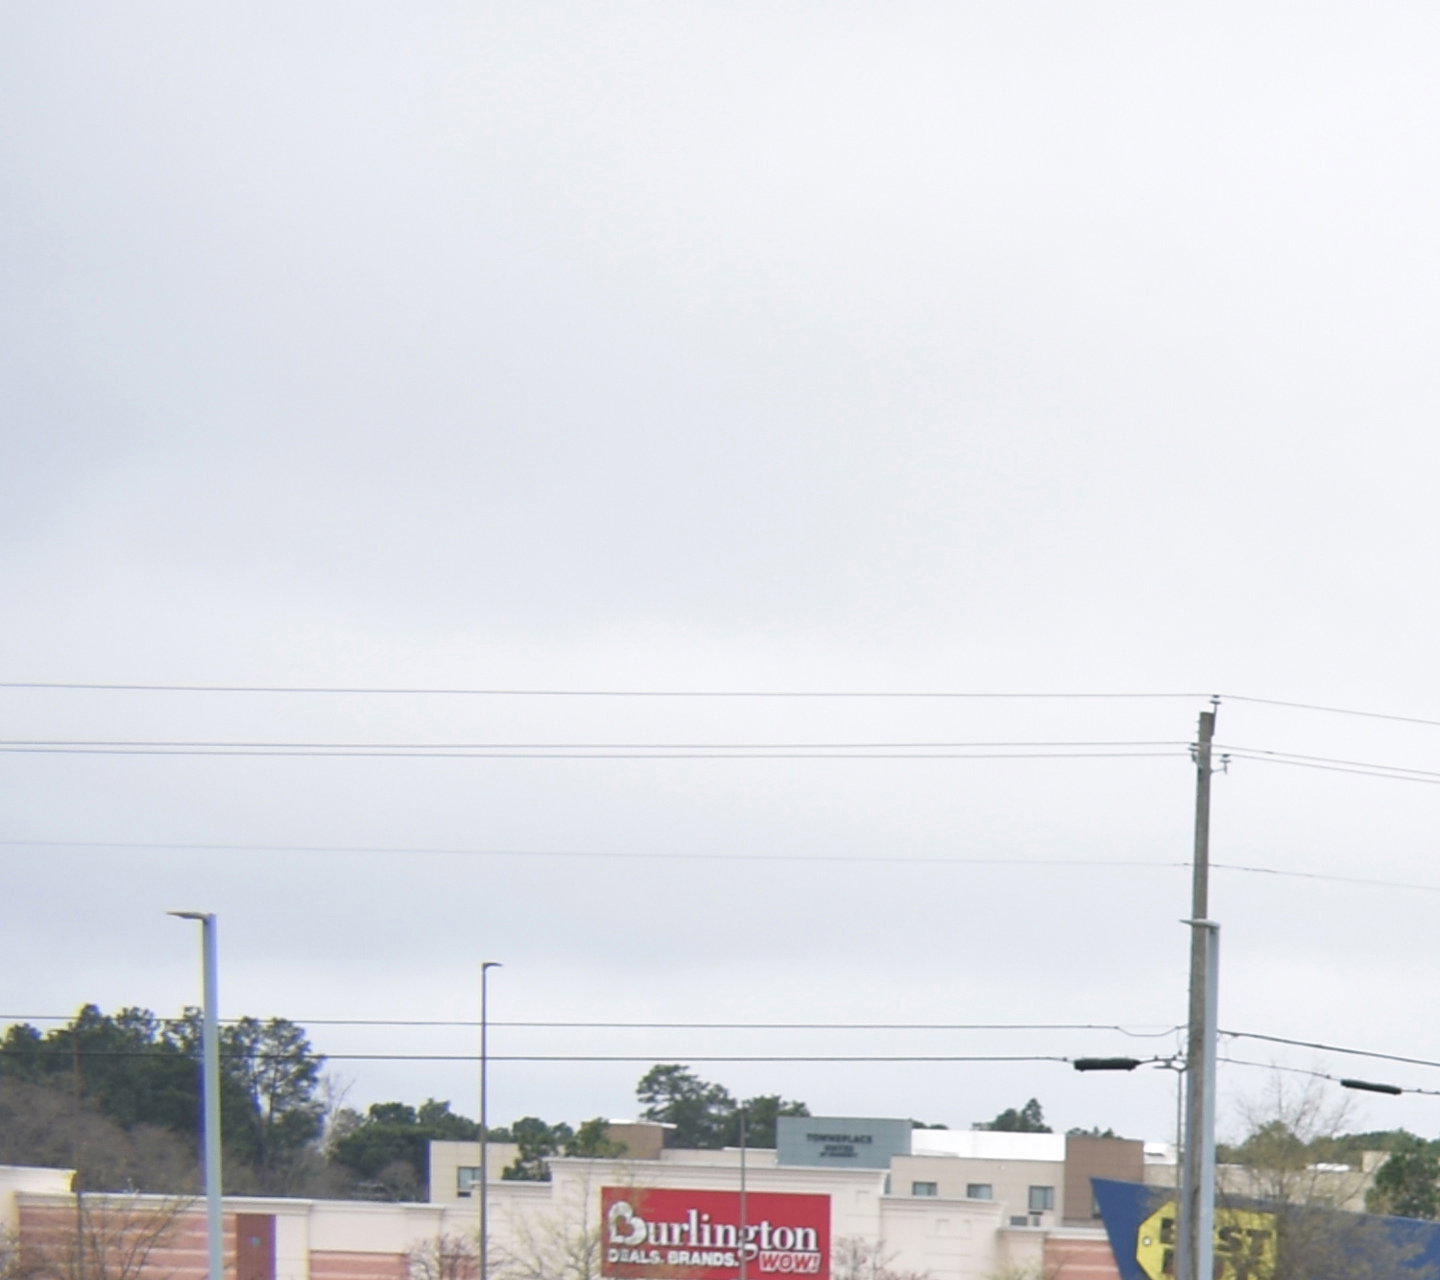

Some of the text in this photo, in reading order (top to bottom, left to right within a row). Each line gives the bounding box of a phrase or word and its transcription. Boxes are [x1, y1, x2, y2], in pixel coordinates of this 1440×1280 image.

[607, 1200, 818, 1261] Burlington
[1160, 1218, 1273, 1254] BST
[758, 1252, 822, 1275] WOW!
